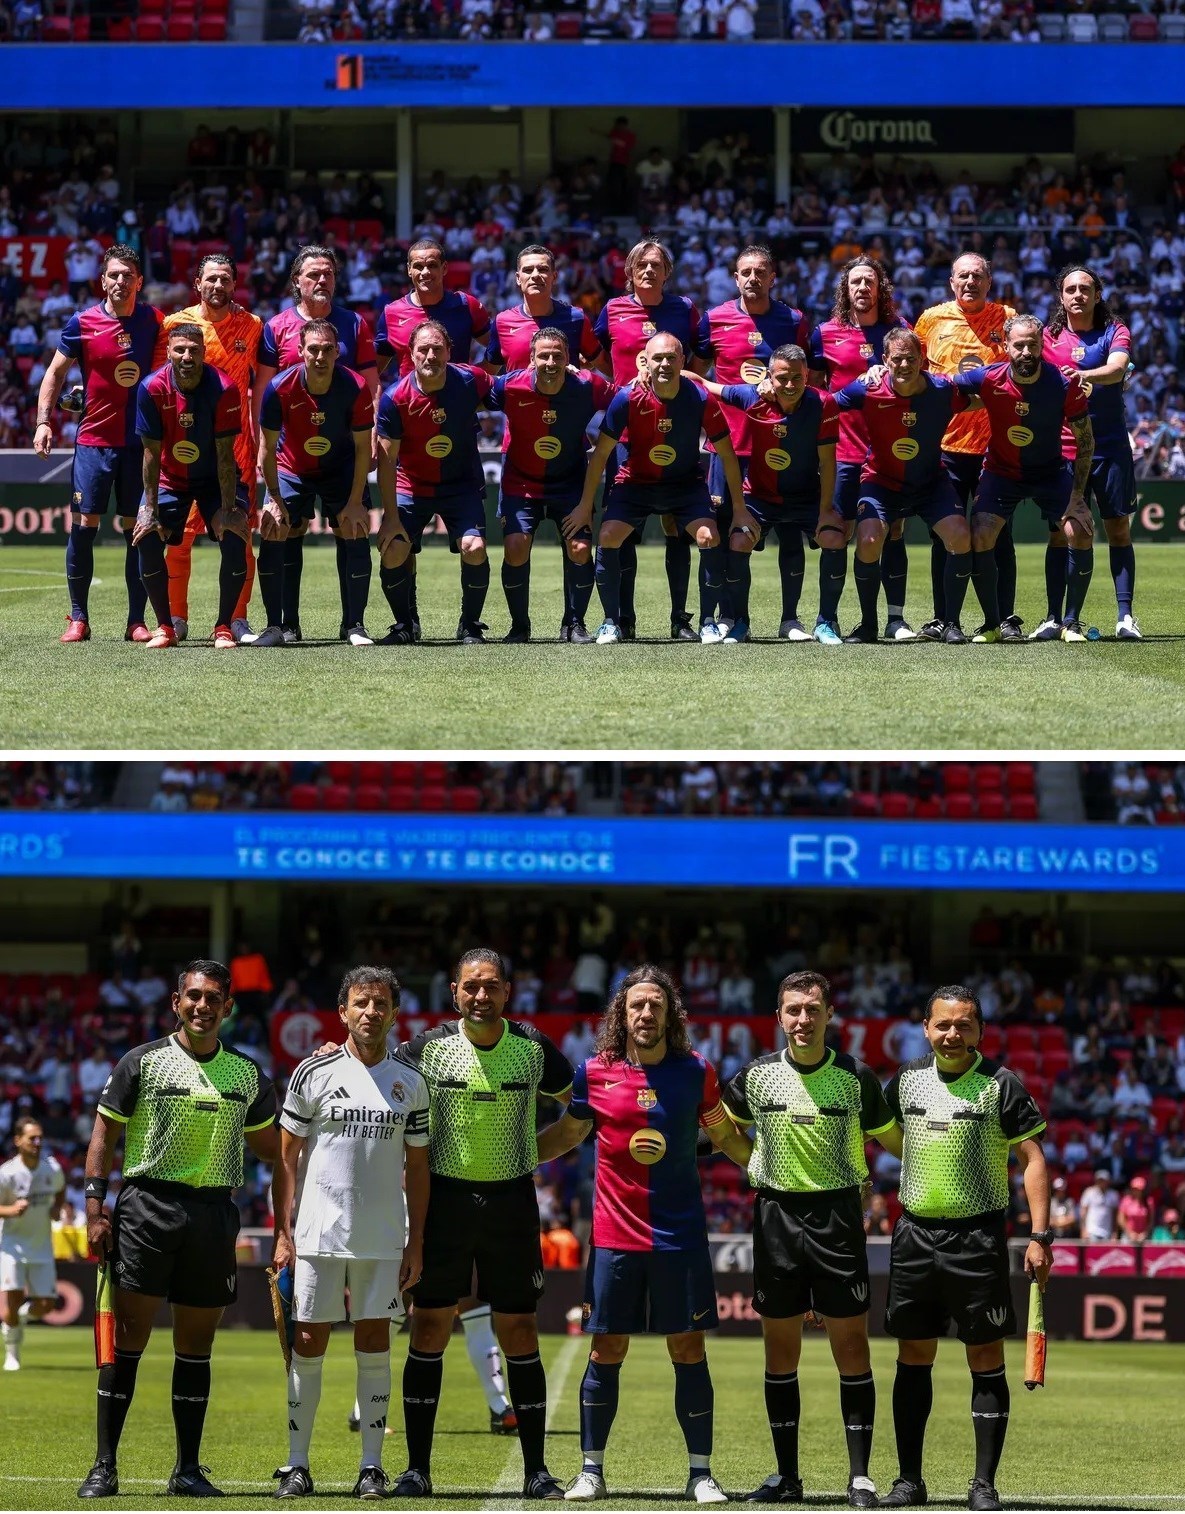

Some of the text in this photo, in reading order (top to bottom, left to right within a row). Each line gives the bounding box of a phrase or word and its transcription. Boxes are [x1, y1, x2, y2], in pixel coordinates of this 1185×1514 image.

[821, 112, 938, 149] Corona
[237, 847, 615, 873] TE CONOCE Y TE RECONOCE
[790, 834, 1158, 878] FR FIESTAREWARDS
[331, 1105, 404, 1125] Emirates
[342, 1124, 395, 1140] FLY BETTER
[1083, 1294, 1167, 1340] DE
